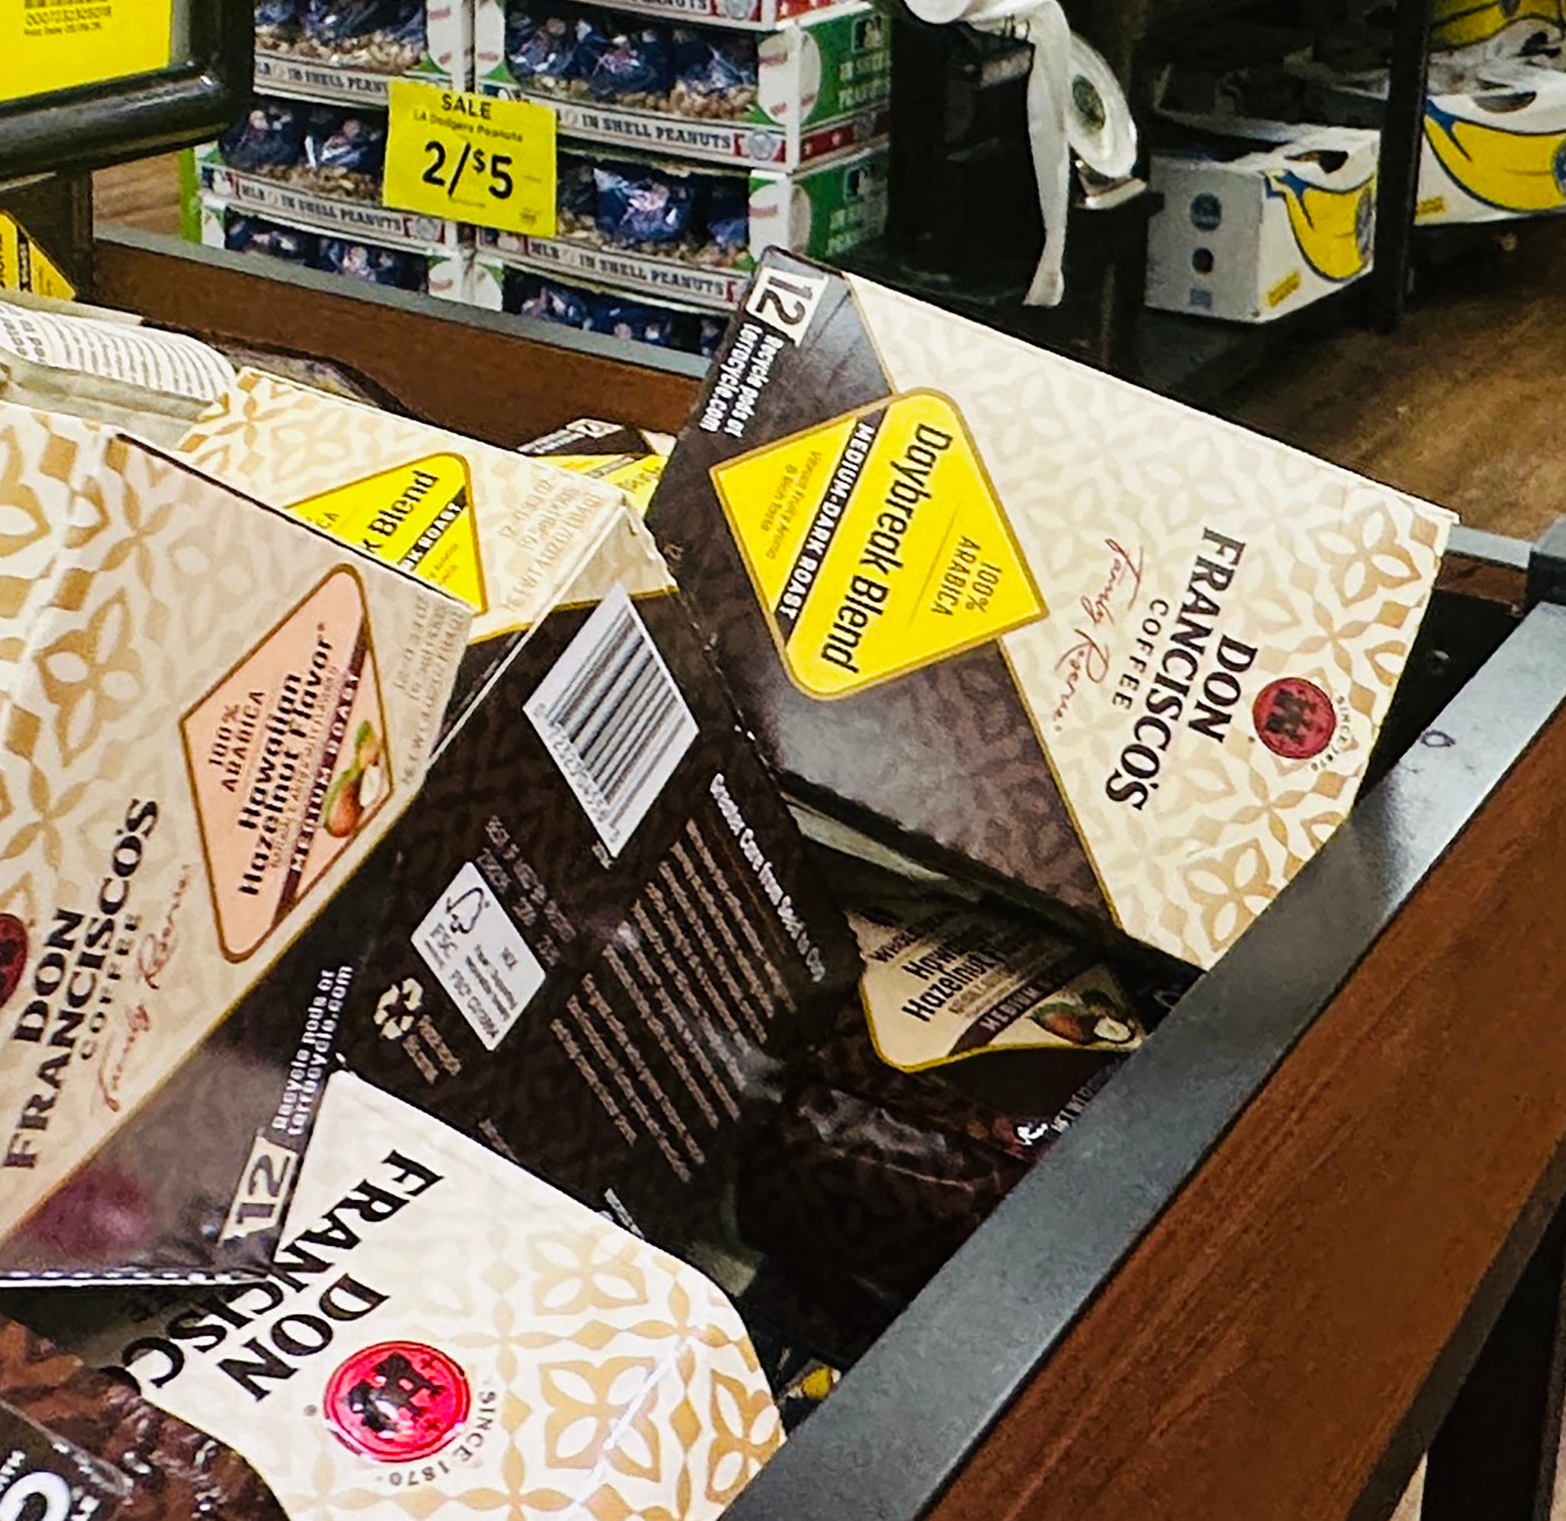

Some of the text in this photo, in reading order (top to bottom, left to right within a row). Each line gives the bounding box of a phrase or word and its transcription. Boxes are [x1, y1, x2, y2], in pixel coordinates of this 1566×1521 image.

[441, 92, 493, 121] SALE
[582, 113, 732, 150] IN SHELL PEANUTS
[281, 192, 297, 209] IN
[297, 196, 337, 220] SHELL
[339, 206, 403, 232] PEANUTS
[578, 253, 597, 270] IN
[599, 257, 648, 282] SHELL
[649, 266, 727, 296] PEANUTS
[754, 274, 813, 330] 12
[700, 324, 761, 432] terracycle.com
[747, 336, 784, 386] Recycle
[731, 386, 758, 417] pods
[366, 469, 442, 540] Blend
[821, 425, 952, 672] Daybreak Blend
[931, 538, 979, 618] ARABICA
[965, 563, 1001, 612] 100%
[779, 558, 815, 619] ROAST
[1104, 526, 1248, 812] FRANCISCO'S
[1112, 597, 1170, 711] COFFEE
[1193, 642, 1259, 745] DON
[236, 673, 303, 831] Hawaiian
[238, 747, 300, 896] Hazelnut
[1, 797, 159, 1171] FRANCISCO'S
[14, 906, 86, 1045] DON
[900, 946, 997, 1022] Hazelnut
[235, 1152, 292, 1226] 12
[216, 1272, 392, 1404] DON
[387, 1390, 498, 1488] SINCE 1870
